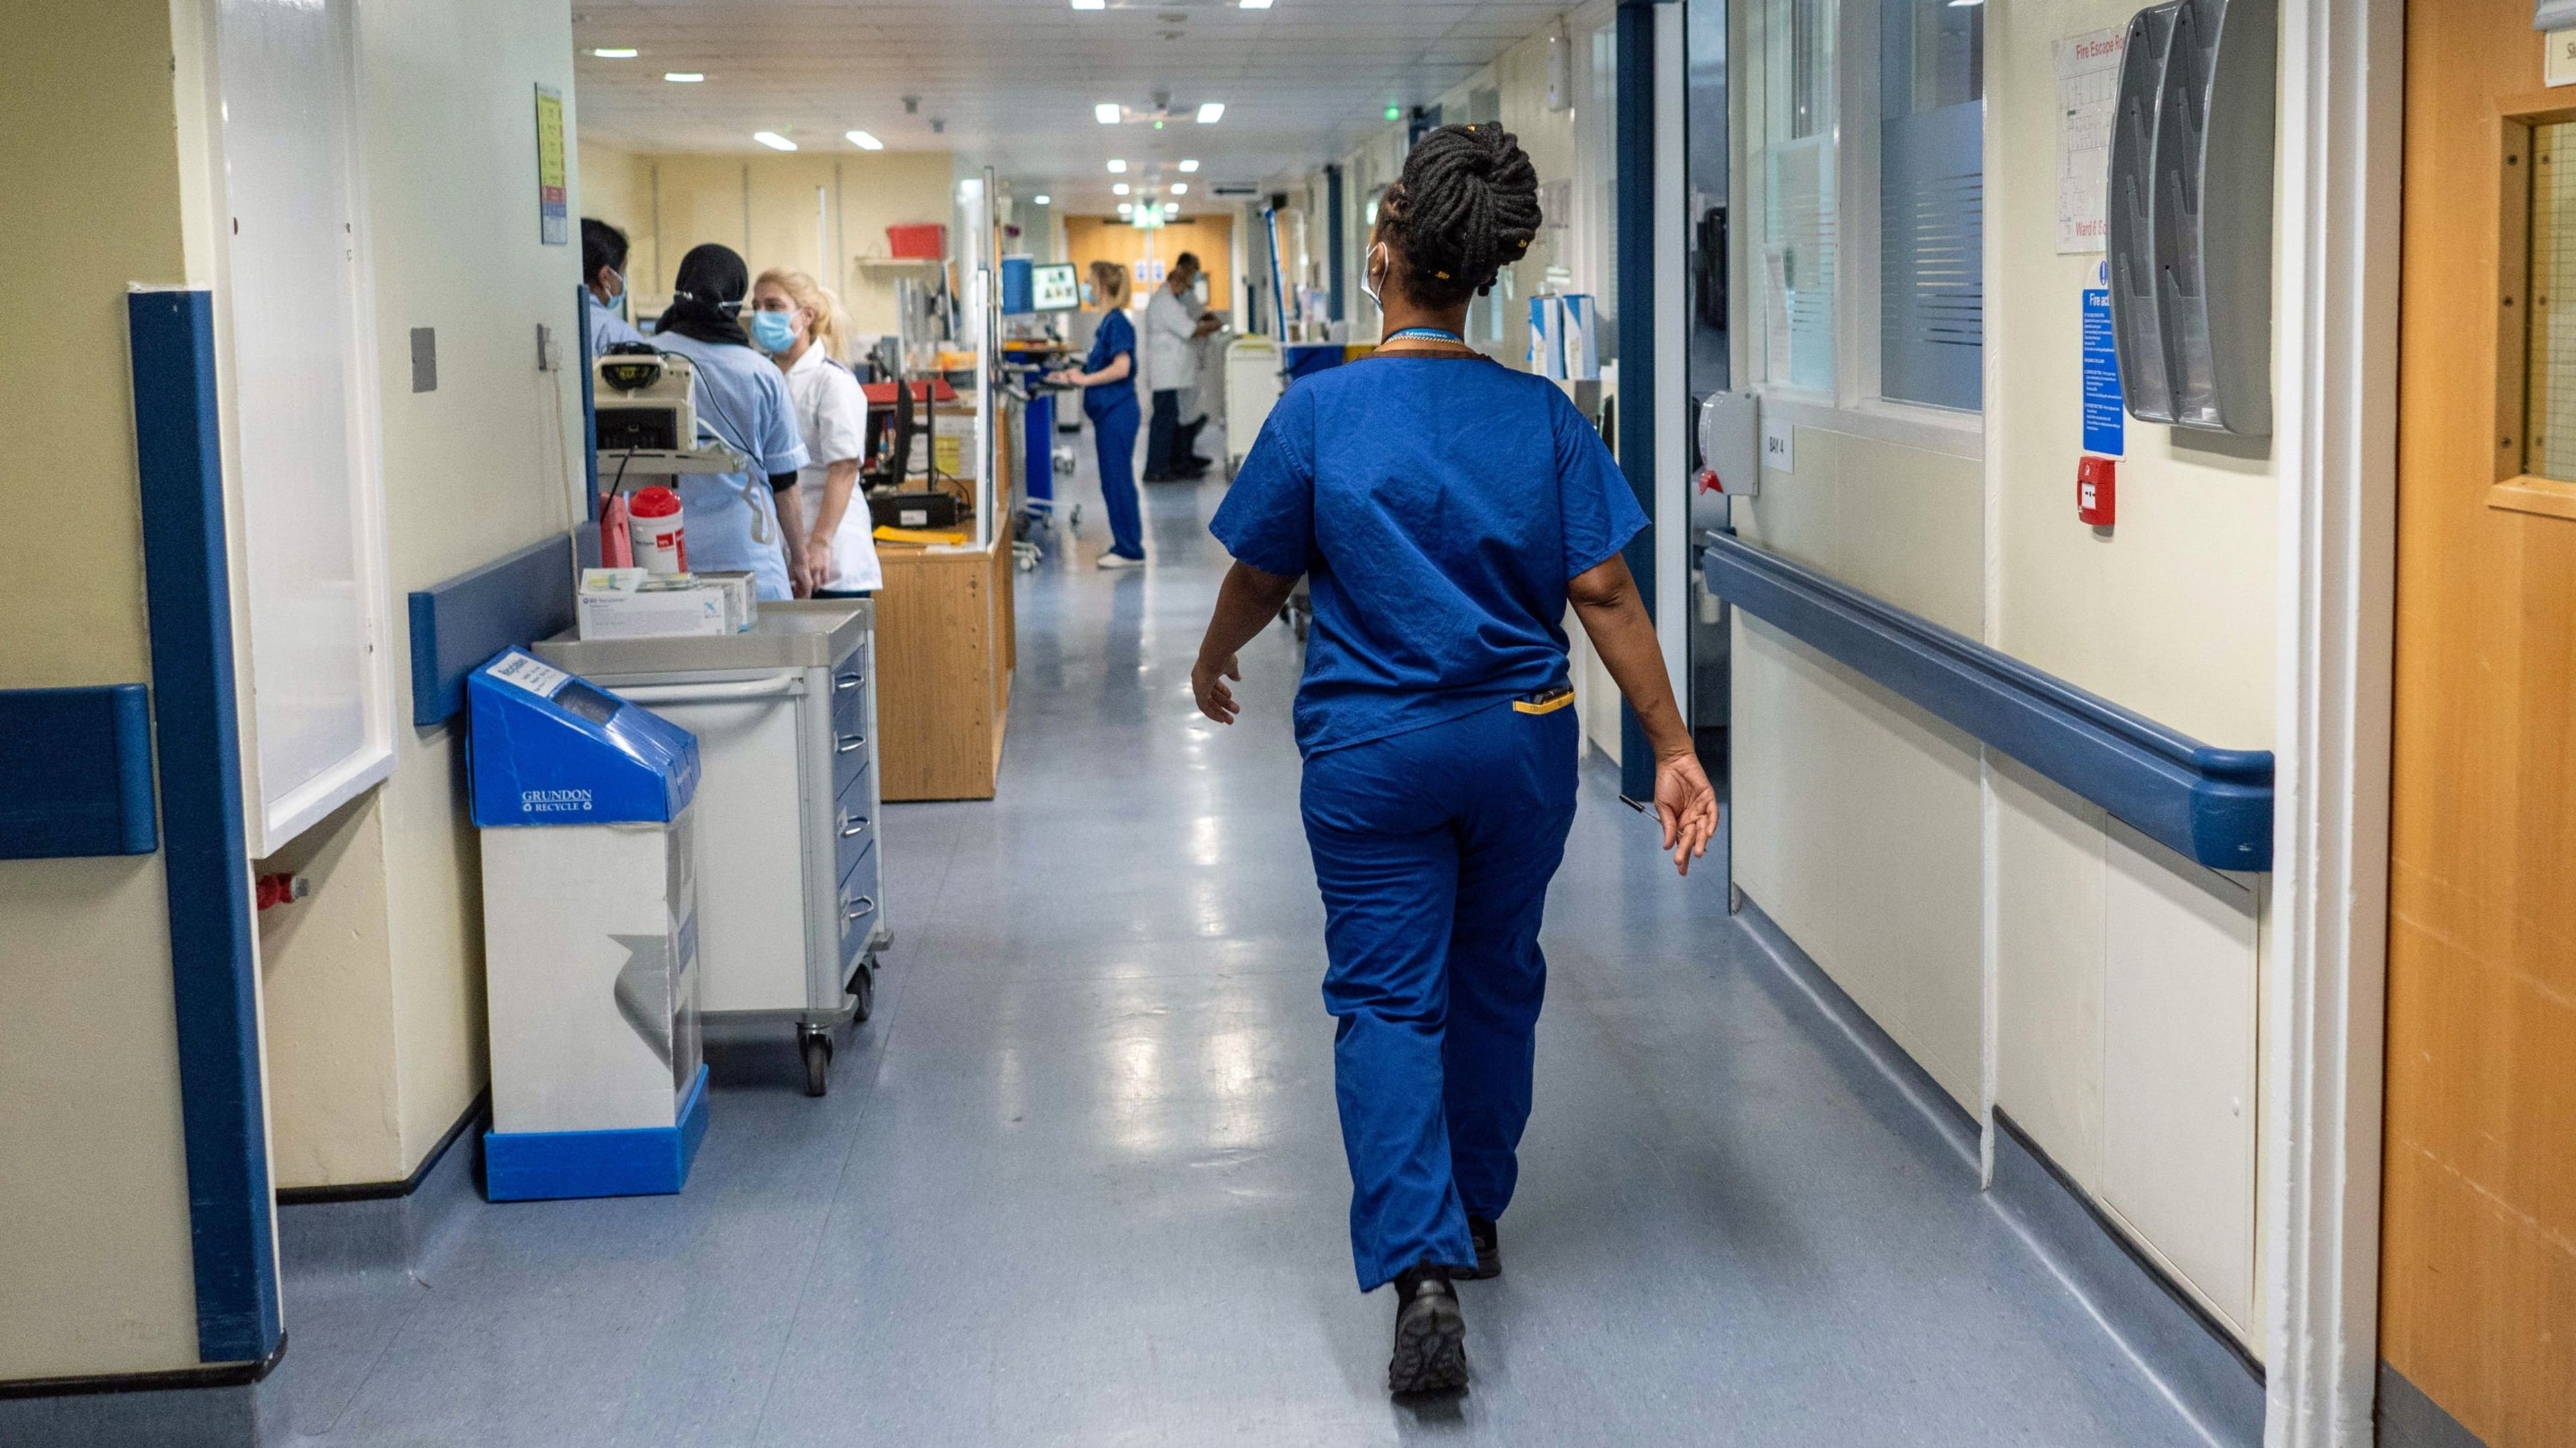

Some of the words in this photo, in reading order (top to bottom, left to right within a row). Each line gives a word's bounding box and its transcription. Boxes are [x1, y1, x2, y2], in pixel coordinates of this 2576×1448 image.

[2076, 44, 2089, 60] Fire
[2090, 40, 2114, 58] Escape
[2076, 220, 2092, 237] Ward
[2090, 293, 2100, 307] Fire
[1770, 436, 1779, 453] BAY
[1780, 439, 1784, 455] 4
[522, 789, 592, 801] GRUNDON
[535, 803, 579, 812] RECYCLE
